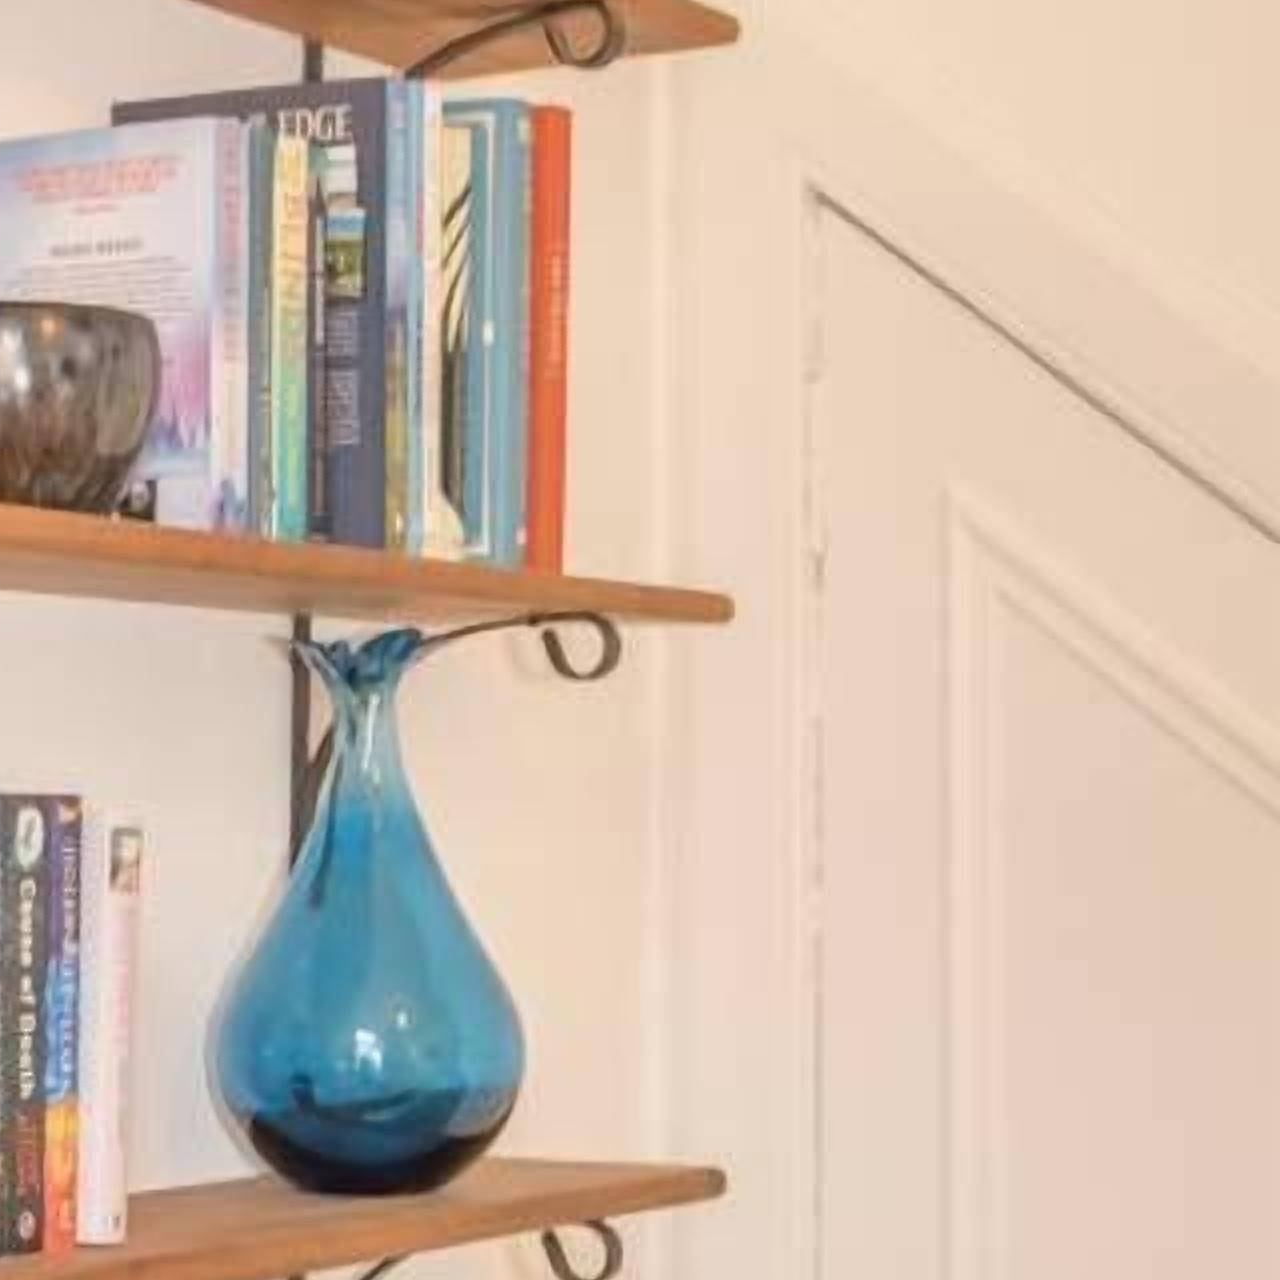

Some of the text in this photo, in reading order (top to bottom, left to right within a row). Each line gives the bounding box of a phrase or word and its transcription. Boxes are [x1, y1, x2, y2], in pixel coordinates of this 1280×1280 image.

[277, 104, 352, 140] EDGE
[19, 877, 37, 967] Cause
[19, 974, 37, 1007] of
[19, 1012, 37, 1100] Death
